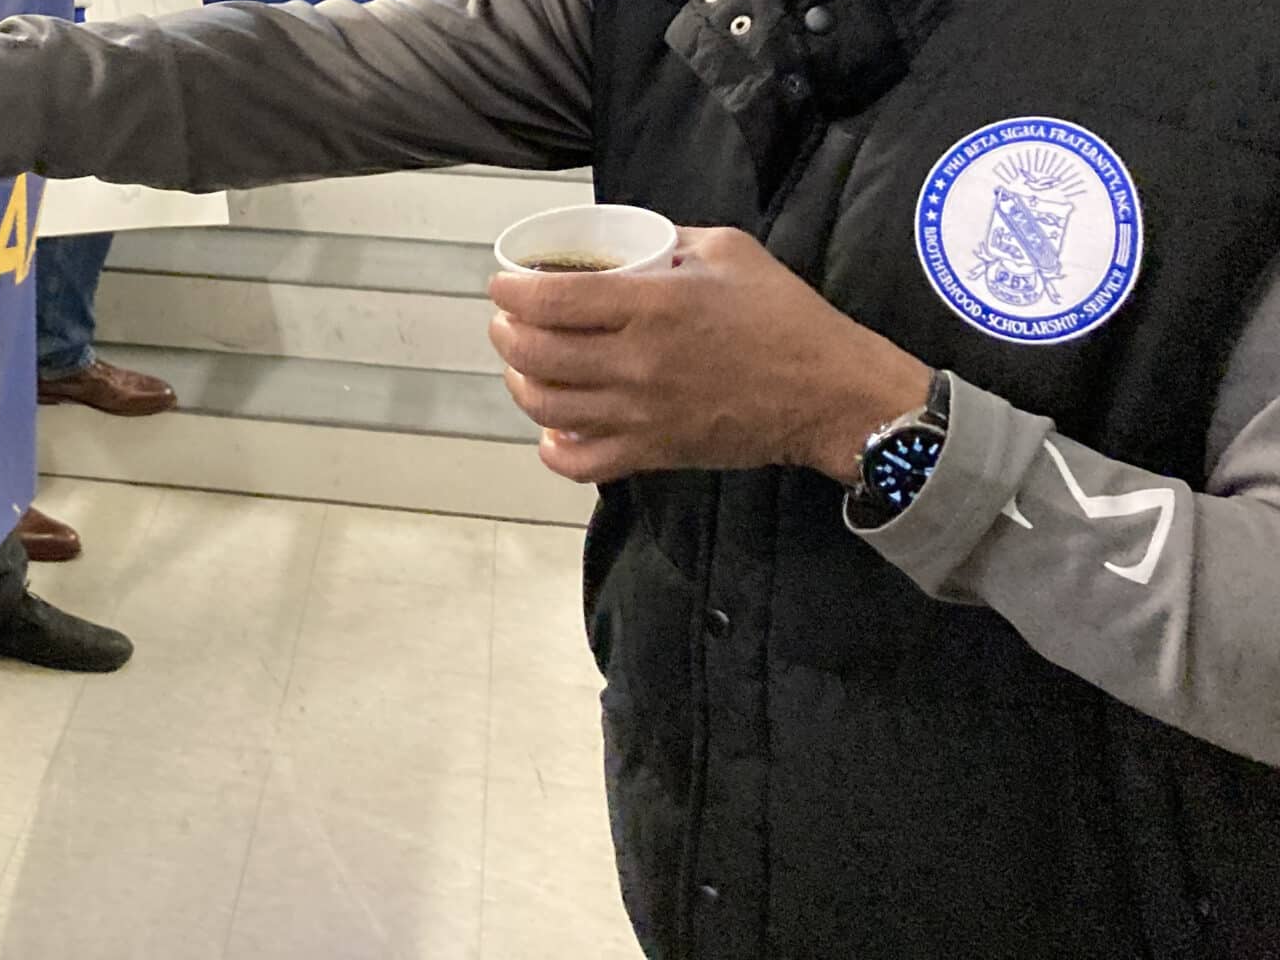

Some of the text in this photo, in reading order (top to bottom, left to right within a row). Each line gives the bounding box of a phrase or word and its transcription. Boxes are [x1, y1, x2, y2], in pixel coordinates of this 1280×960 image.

[943, 154, 967, 177] PHI
[963, 133, 1000, 159] BETA
[999, 125, 1045, 140] SIGMA
[923, 226, 1127, 335] BROTHERHOOD SCHOLARSHIP SERVICE
